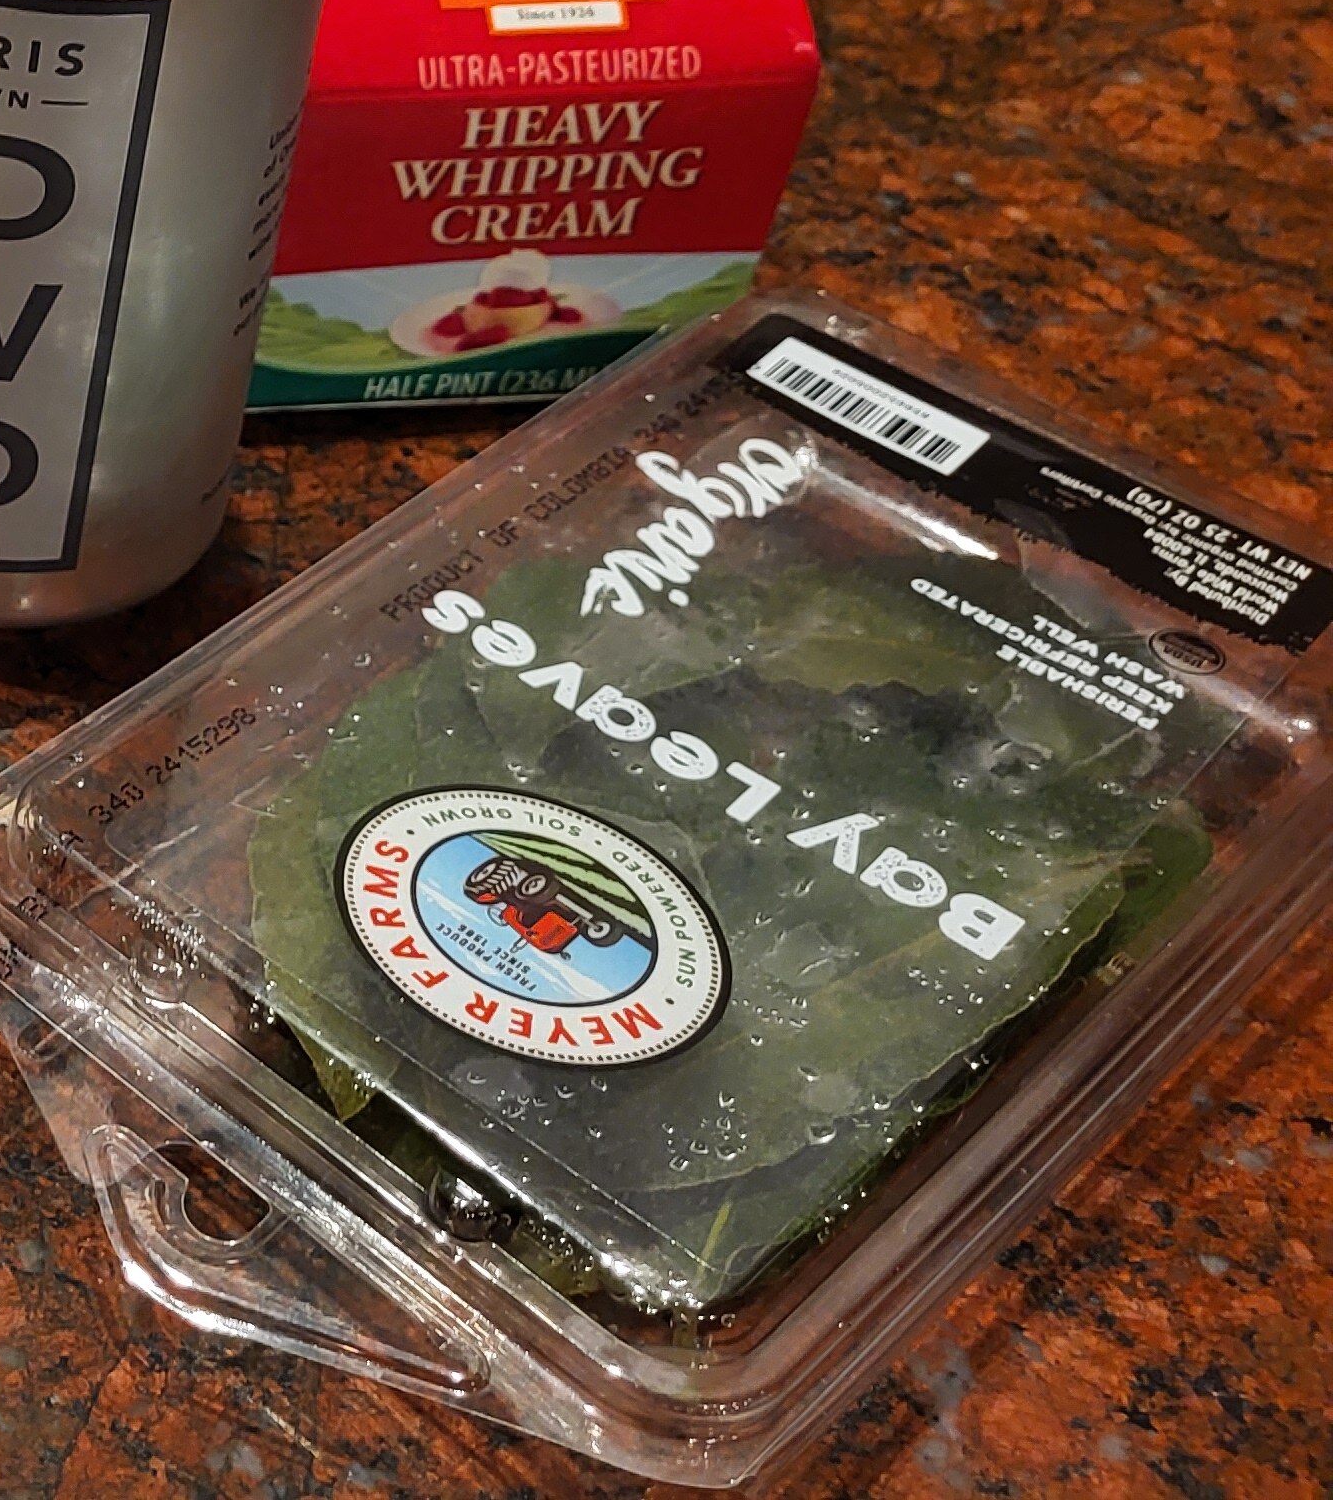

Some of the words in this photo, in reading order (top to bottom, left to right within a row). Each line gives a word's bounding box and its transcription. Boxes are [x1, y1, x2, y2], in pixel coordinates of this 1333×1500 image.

[418, 45, 702, 91] ULTRA-PASTEURIZED
[461, 100, 663, 150] HEAVY
[391, 147, 703, 200] WHIPPING
[431, 197, 642, 245] CREAM
[364, 374, 430, 401] HALF
[434, 371, 494, 398] PINT
[379, 550, 484, 622] PRODUCT
[487, 519, 522, 549] OF
[523, 447, 635, 524] COLOMBIA
[1171, 509, 1201, 530] OZ
[1151, 545, 1195, 574] Farms
[1236, 540, 1271, 561] WT
[1271, 556, 1314, 581] NET
[1187, 580, 1270, 626] Distributed
[1197, 568, 1234, 596] Wide
[1233, 585, 1279, 615] World
[910, 578, 1100, 677] REFRIGERATED
[1032, 614, 1099, 658] WELL
[996, 644, 1159, 731] PERISHABLE
[1101, 674, 1174, 715] KEEP
[1104, 652, 1185, 699] WASH
[422, 589, 782, 823] Leaves
[421, 806, 512, 828] GROWN
[523, 811, 580, 837] SOIL
[612, 850, 694, 940] POWERED
[785, 812, 1026, 961] Bay
[364, 841, 450, 989] FARMS
[676, 947, 696, 988] SUN
[464, 992, 664, 1046] MEYER
